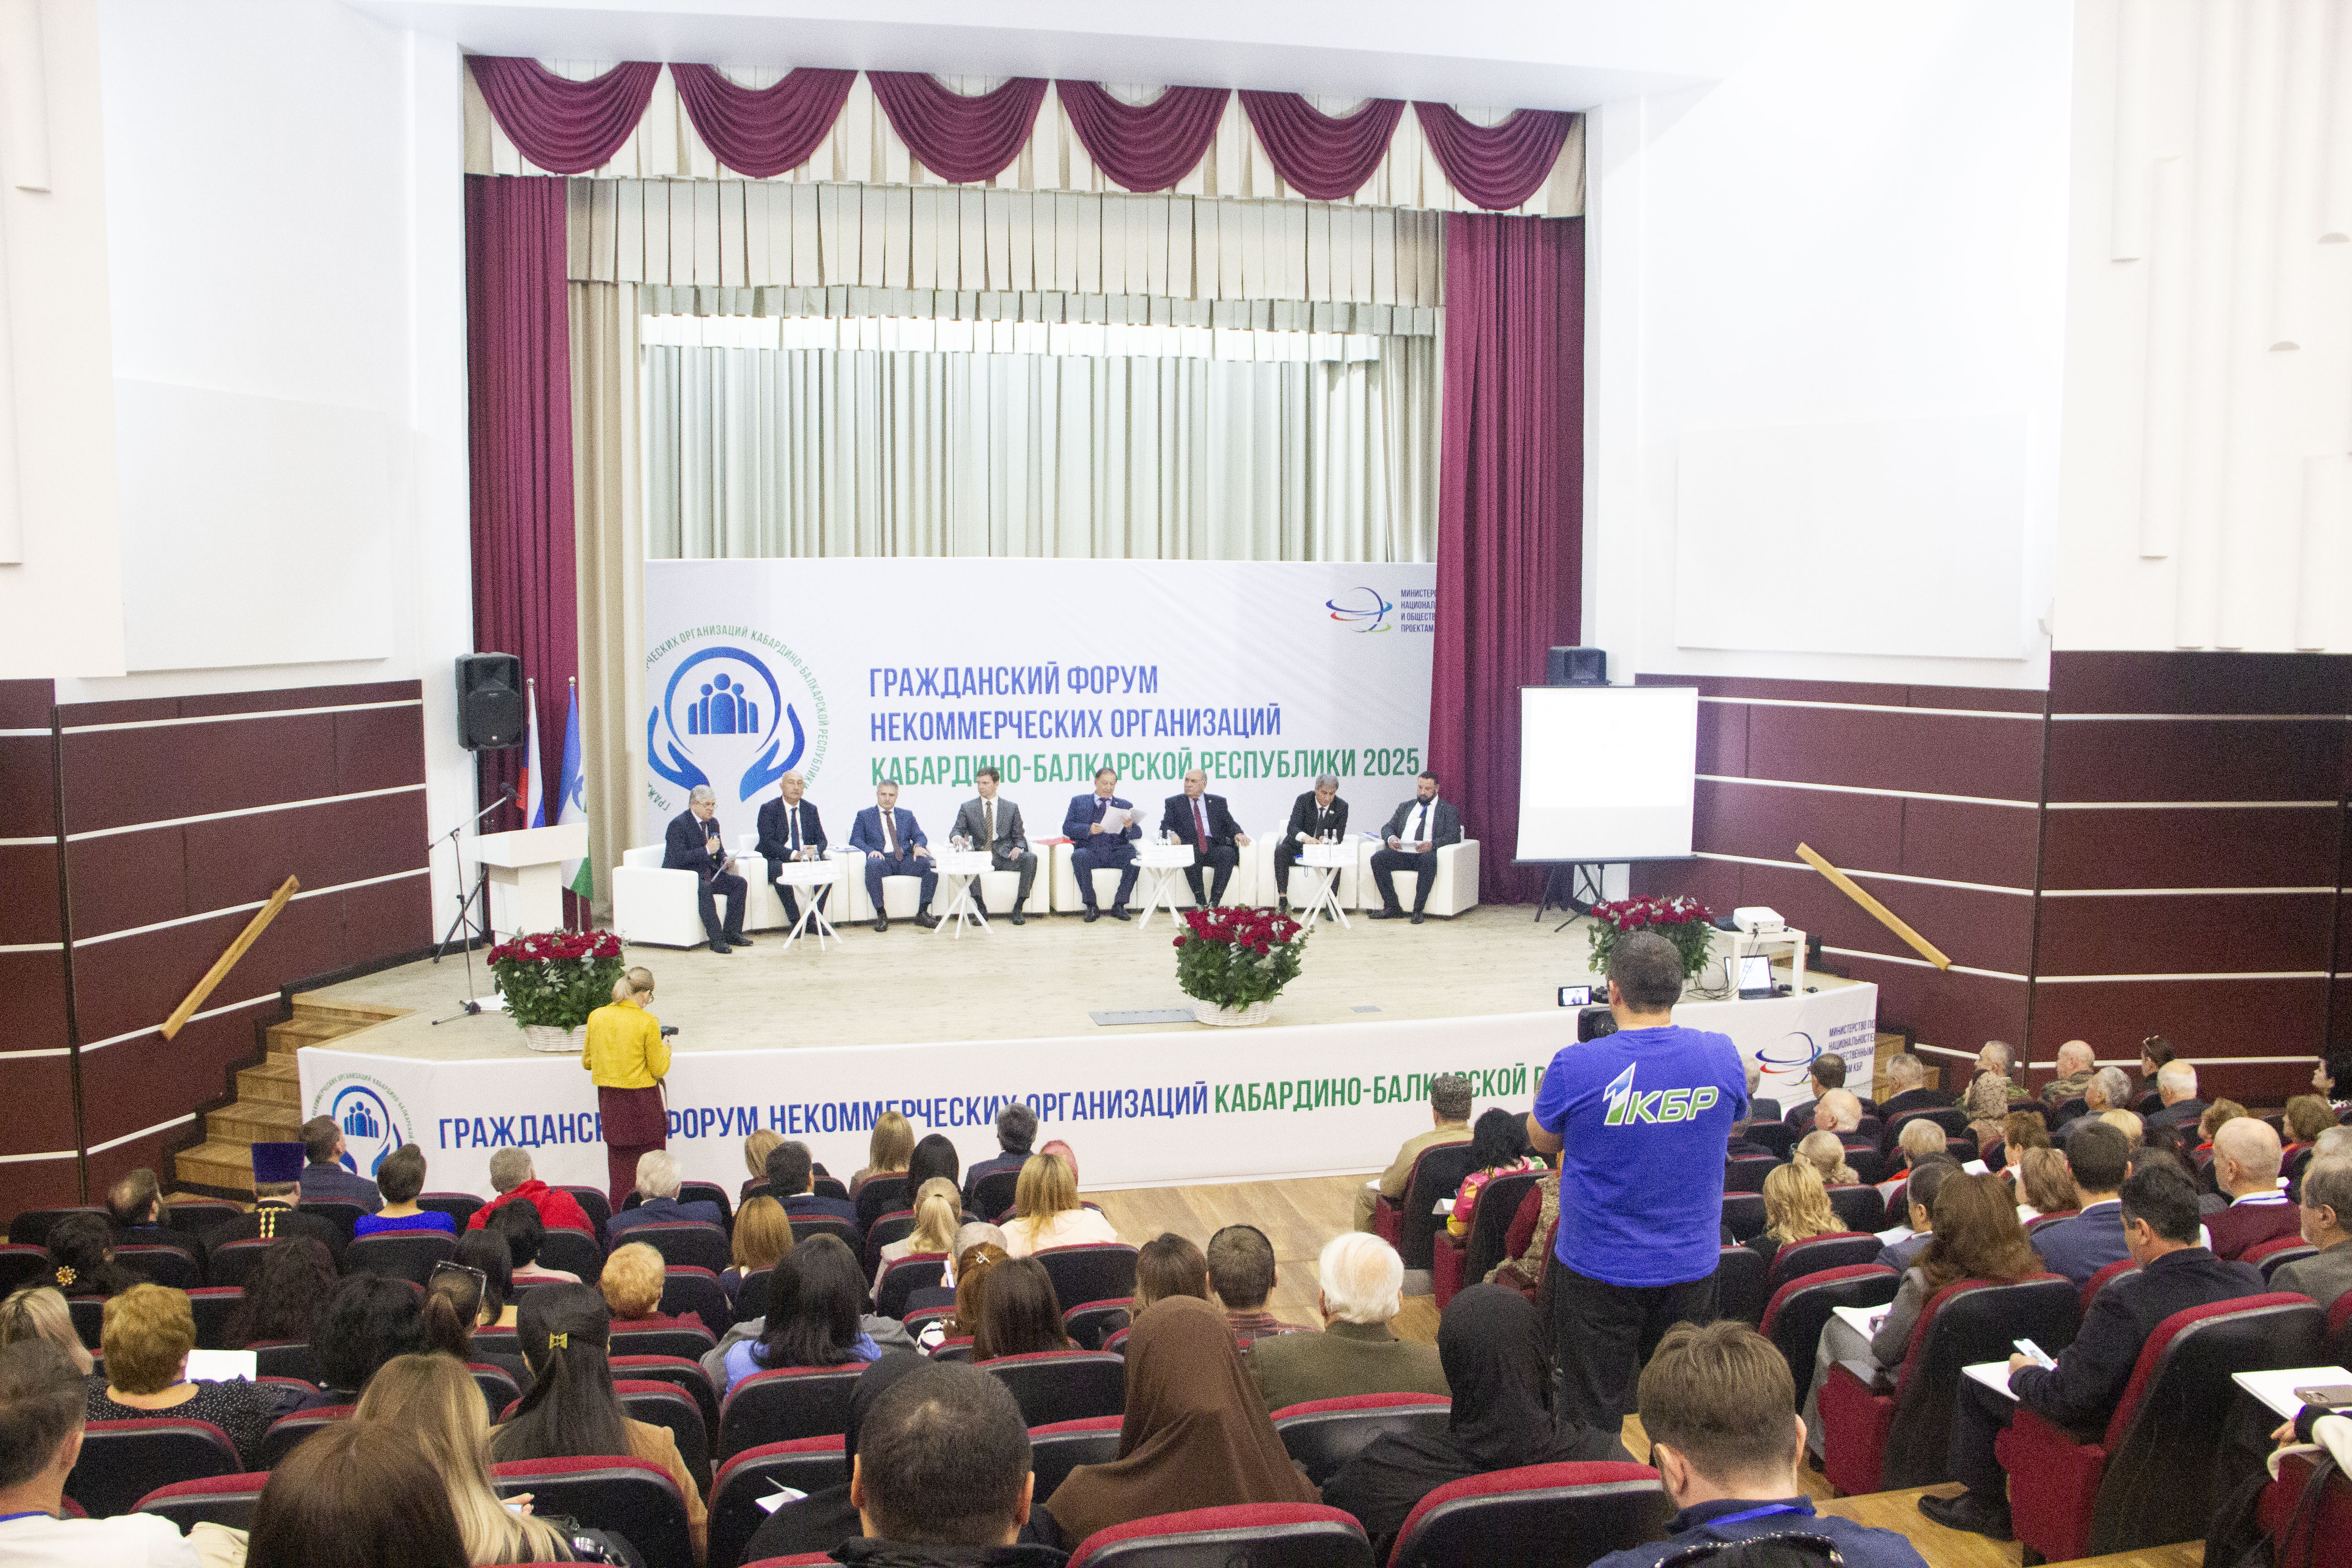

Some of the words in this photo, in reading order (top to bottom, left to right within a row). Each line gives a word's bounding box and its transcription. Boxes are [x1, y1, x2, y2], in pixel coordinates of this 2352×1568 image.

[1401, 612, 1405, 621] И
[1407, 612, 1435, 621] ОБЩЕСТВ
[1401, 624, 1434, 632] ПРОЕКТАМ
[679, 625, 748, 642] ОРГАНИЗАЦИЙ
[751, 630, 830, 726] КАБАРДИНО-БАЛКАРСКОЙ
[870, 661, 1059, 699] ГРАЖДАНСКИЙ
[1067, 665, 1158, 694] ФОРУМ
[871, 709, 1103, 741] НЕКОММЕРЧЕСКИХ
[1111, 703, 1281, 738] ОРГАНИЗАЦИЙ
[1200, 749, 1356, 779] РЕСПУБЛИКИ
[1363, 748, 1419, 776] 2025
[439, 1112, 603, 1149] ГРАЖДАНС
[770, 1094, 1017, 1135] НЕКОММРЧЕСКИ
[1215, 1063, 1526, 1114] КАБАРДИНО-БАЛКСКОЙ
